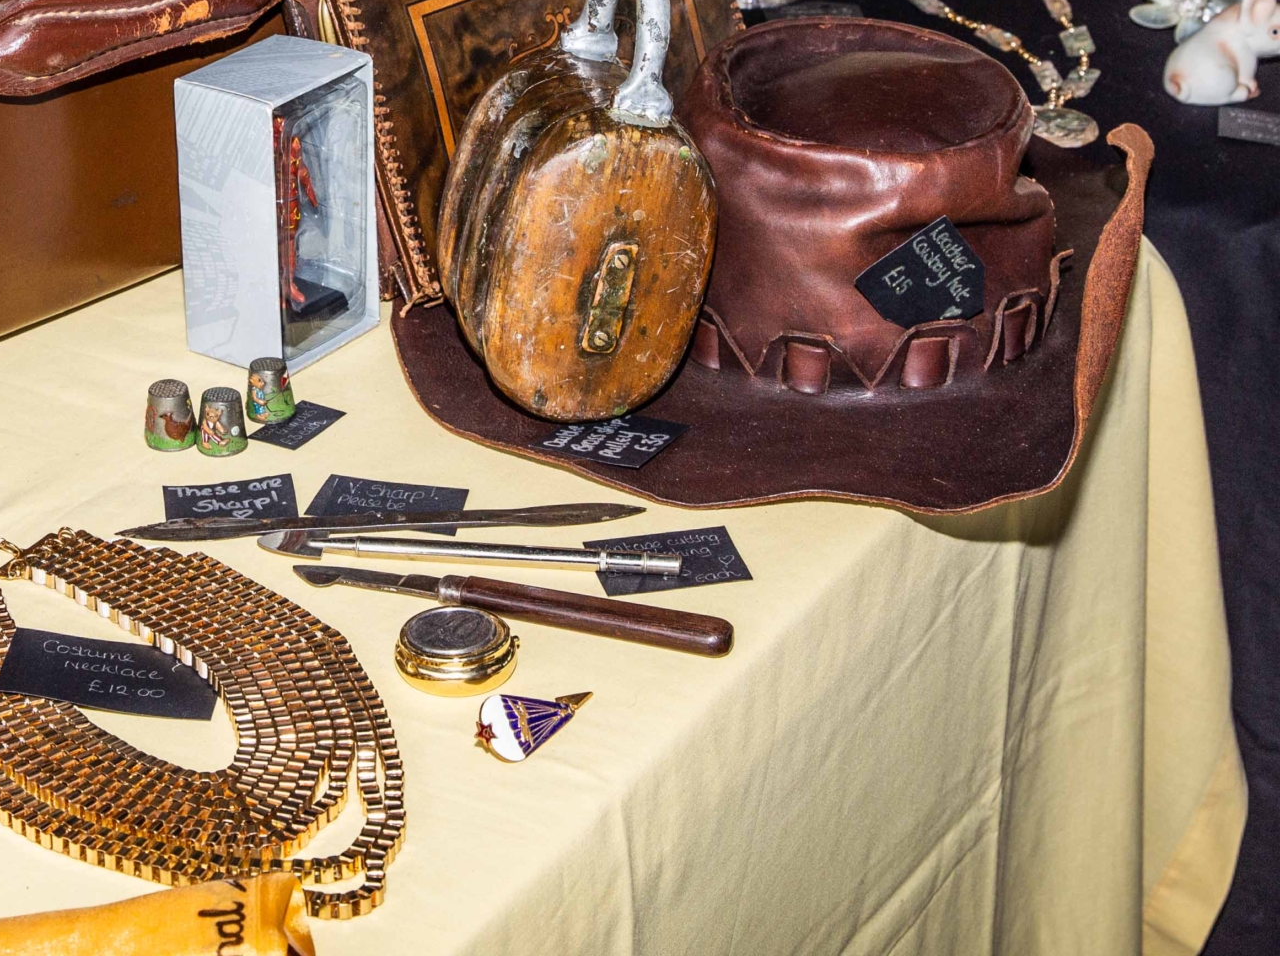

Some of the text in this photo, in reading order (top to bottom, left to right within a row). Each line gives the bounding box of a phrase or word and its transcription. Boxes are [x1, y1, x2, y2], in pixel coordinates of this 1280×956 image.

[881, 265, 913, 295] £15
[168, 477, 283, 498] These are
[386, 498, 406, 511] be
[42, 639, 136, 663] Costume
